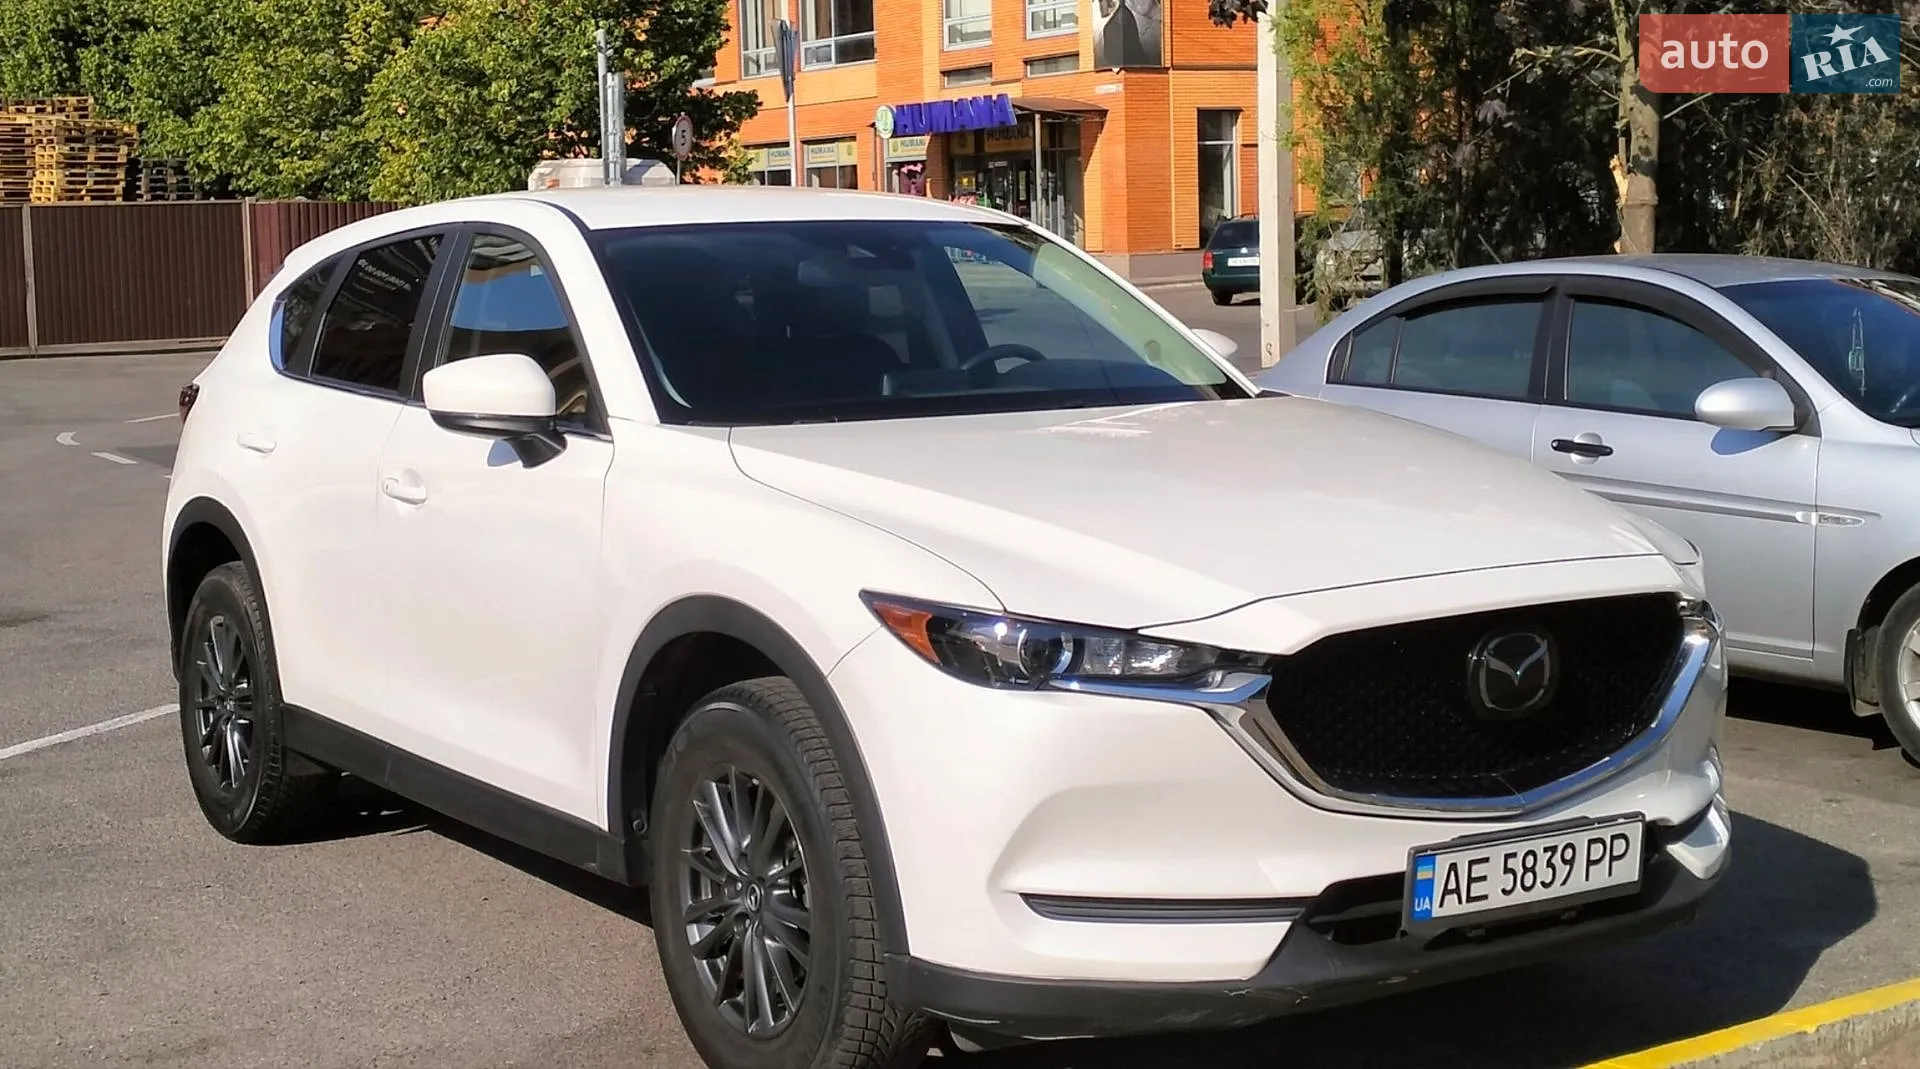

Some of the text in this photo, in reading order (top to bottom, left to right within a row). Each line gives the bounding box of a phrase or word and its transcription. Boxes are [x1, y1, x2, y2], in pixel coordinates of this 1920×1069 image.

[895, 94, 1016, 136] HUMANA
[1438, 832, 1631, 909] AE 5839 PP
[1414, 896, 1431, 912] UA
